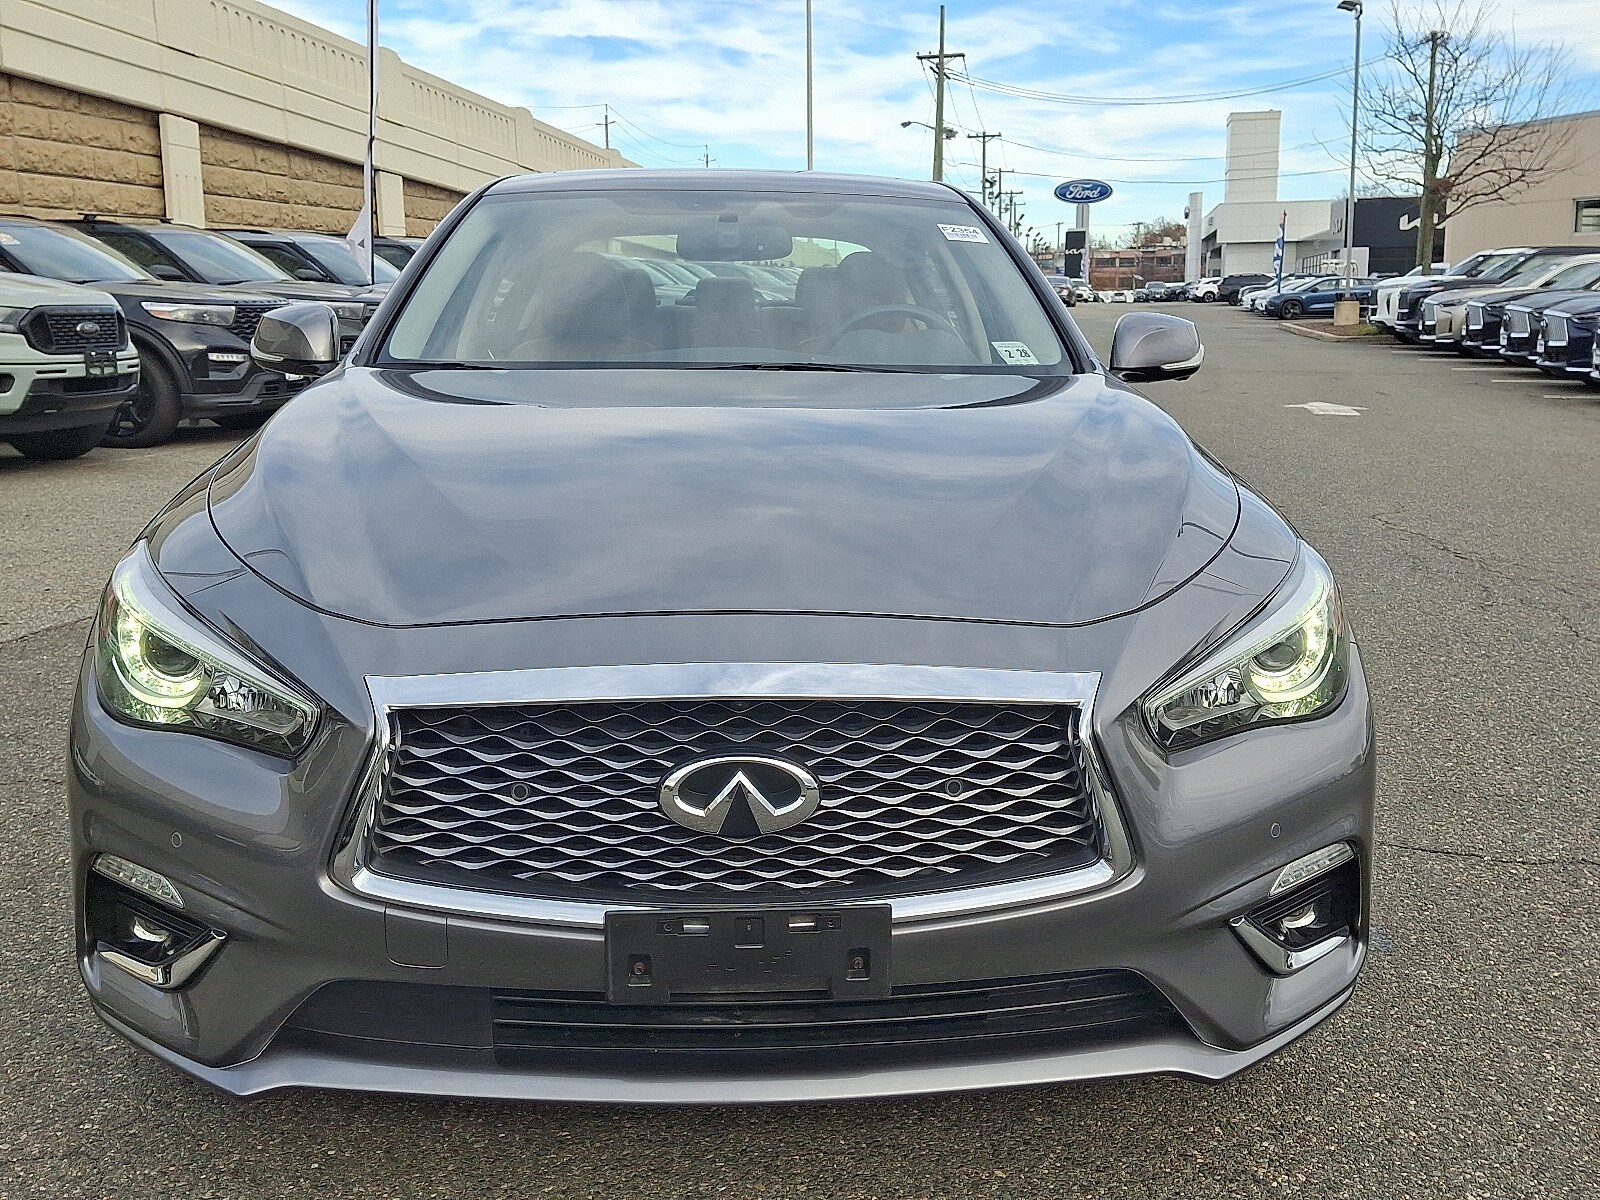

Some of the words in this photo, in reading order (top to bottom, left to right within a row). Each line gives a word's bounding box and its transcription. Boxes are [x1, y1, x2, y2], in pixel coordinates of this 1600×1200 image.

[1065, 183, 1102, 199] Ford
[1004, 349, 1015, 359] 2
[1016, 348, 1031, 358] 28
